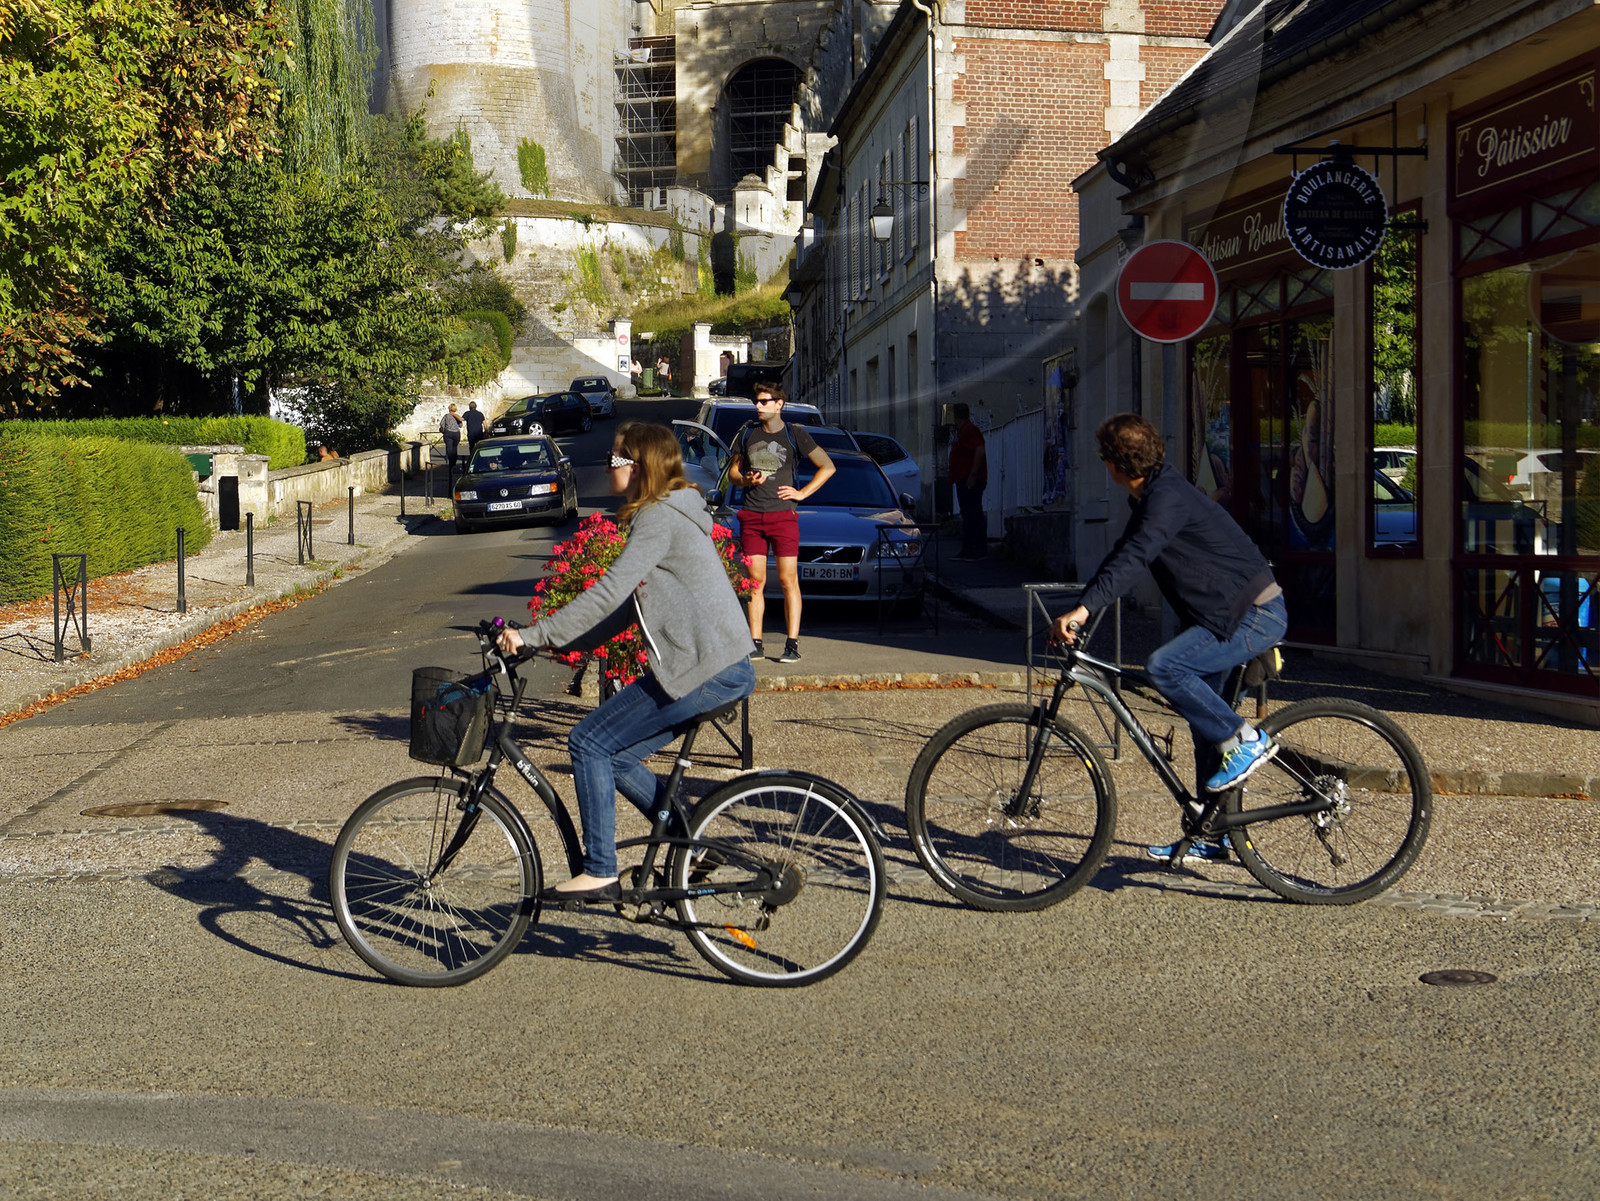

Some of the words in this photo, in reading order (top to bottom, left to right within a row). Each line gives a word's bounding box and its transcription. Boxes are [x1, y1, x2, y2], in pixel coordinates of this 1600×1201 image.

[1477, 114, 1572, 177] Pâtissier
[1296, 170, 1377, 205] BOULANGERIE
[1197, 231, 1242, 262] Artisan
[1295, 225, 1377, 259] ARTISANALE
